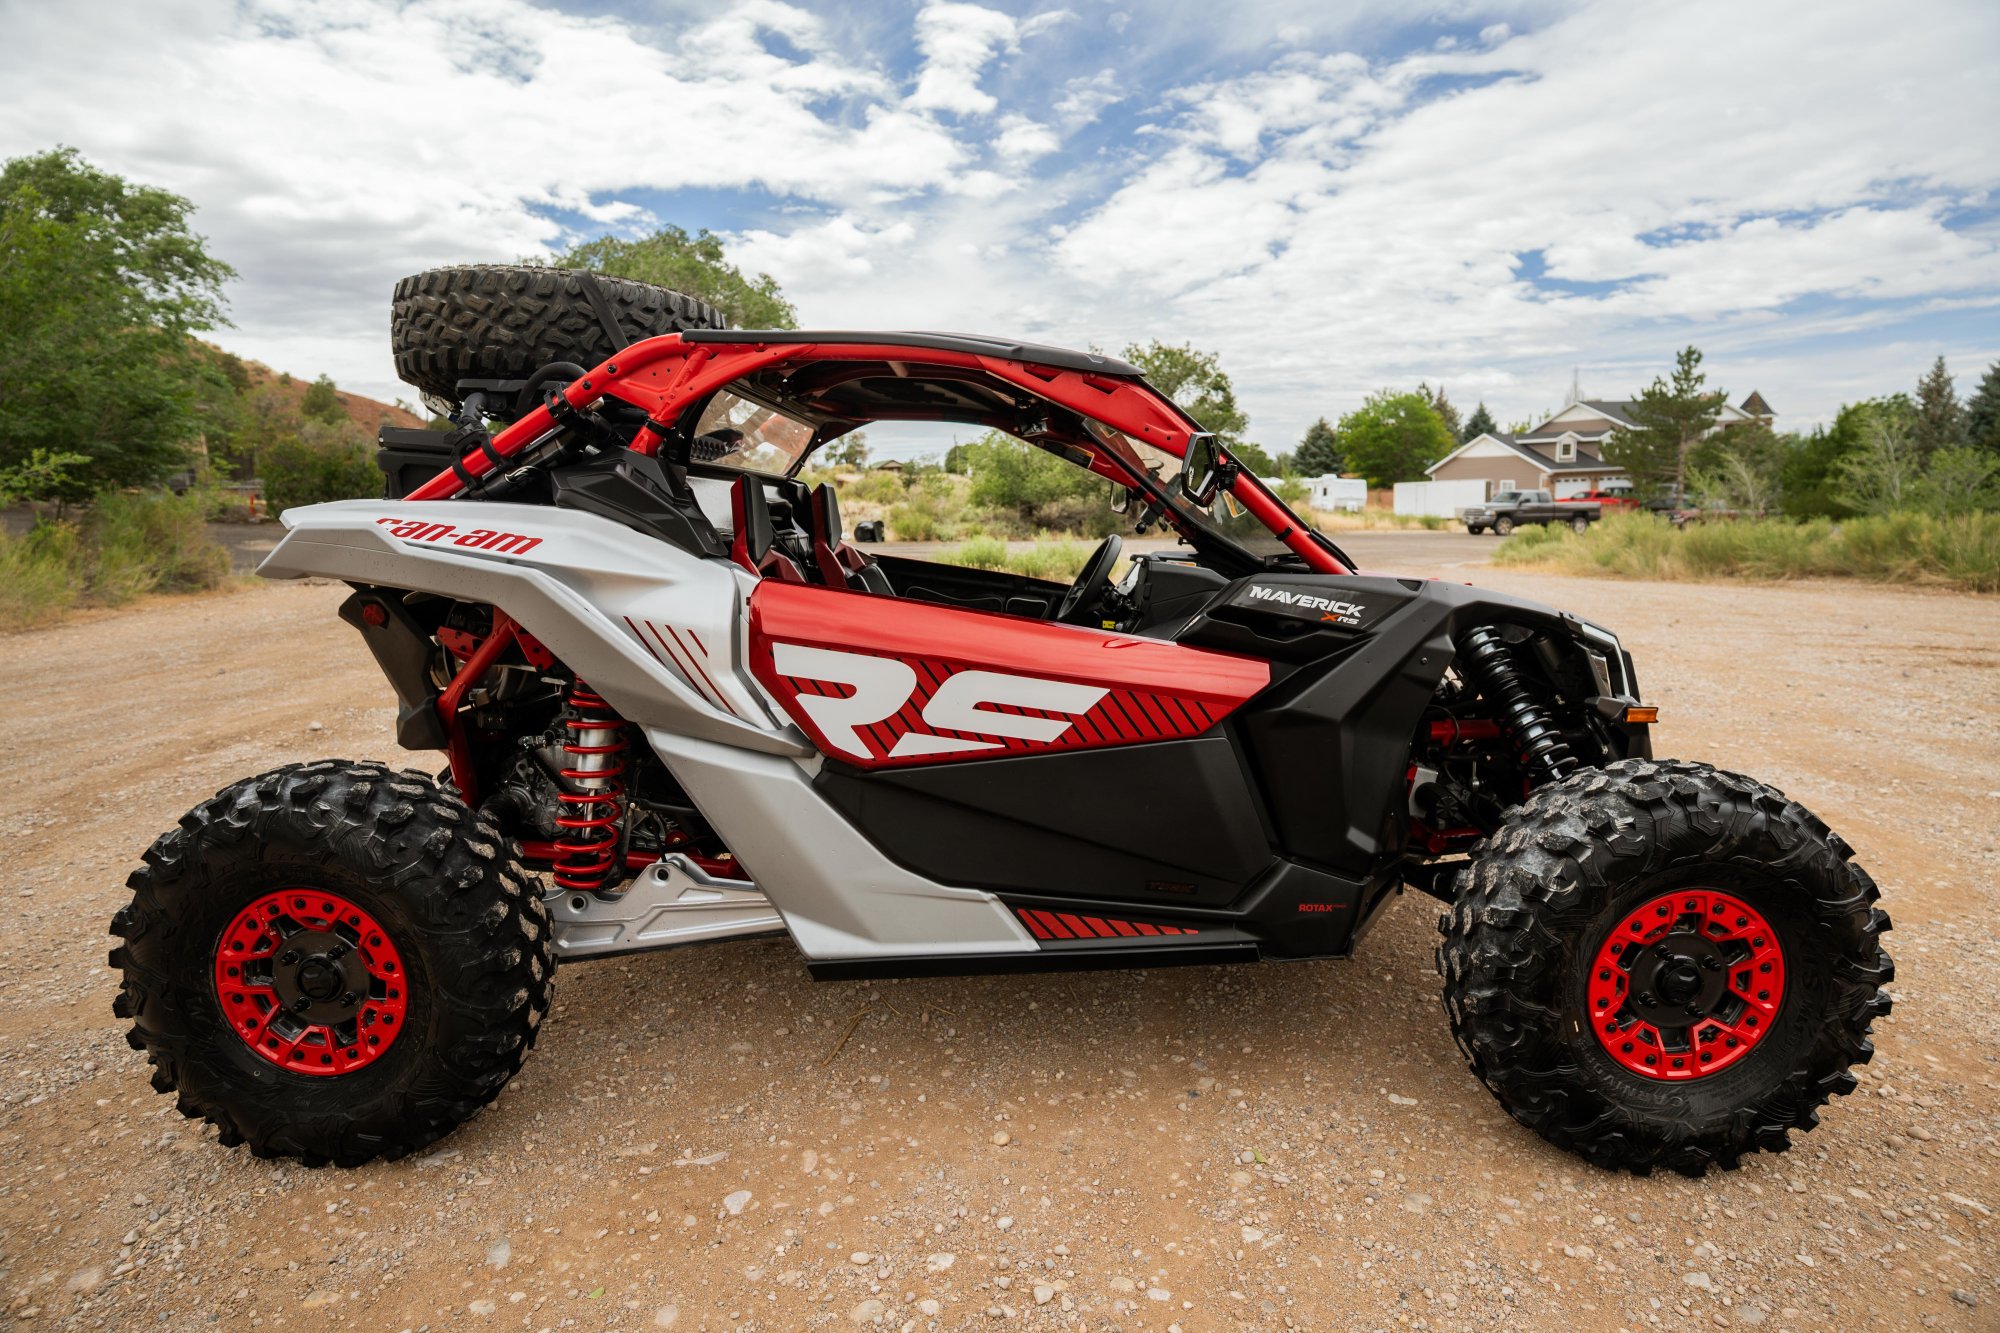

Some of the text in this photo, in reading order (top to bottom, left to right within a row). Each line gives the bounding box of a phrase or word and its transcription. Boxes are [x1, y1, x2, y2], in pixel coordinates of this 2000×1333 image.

[1249, 585, 1366, 618] MAVERICK
[772, 641, 1111, 759] RS
[1299, 903, 1333, 912] ROTAX
